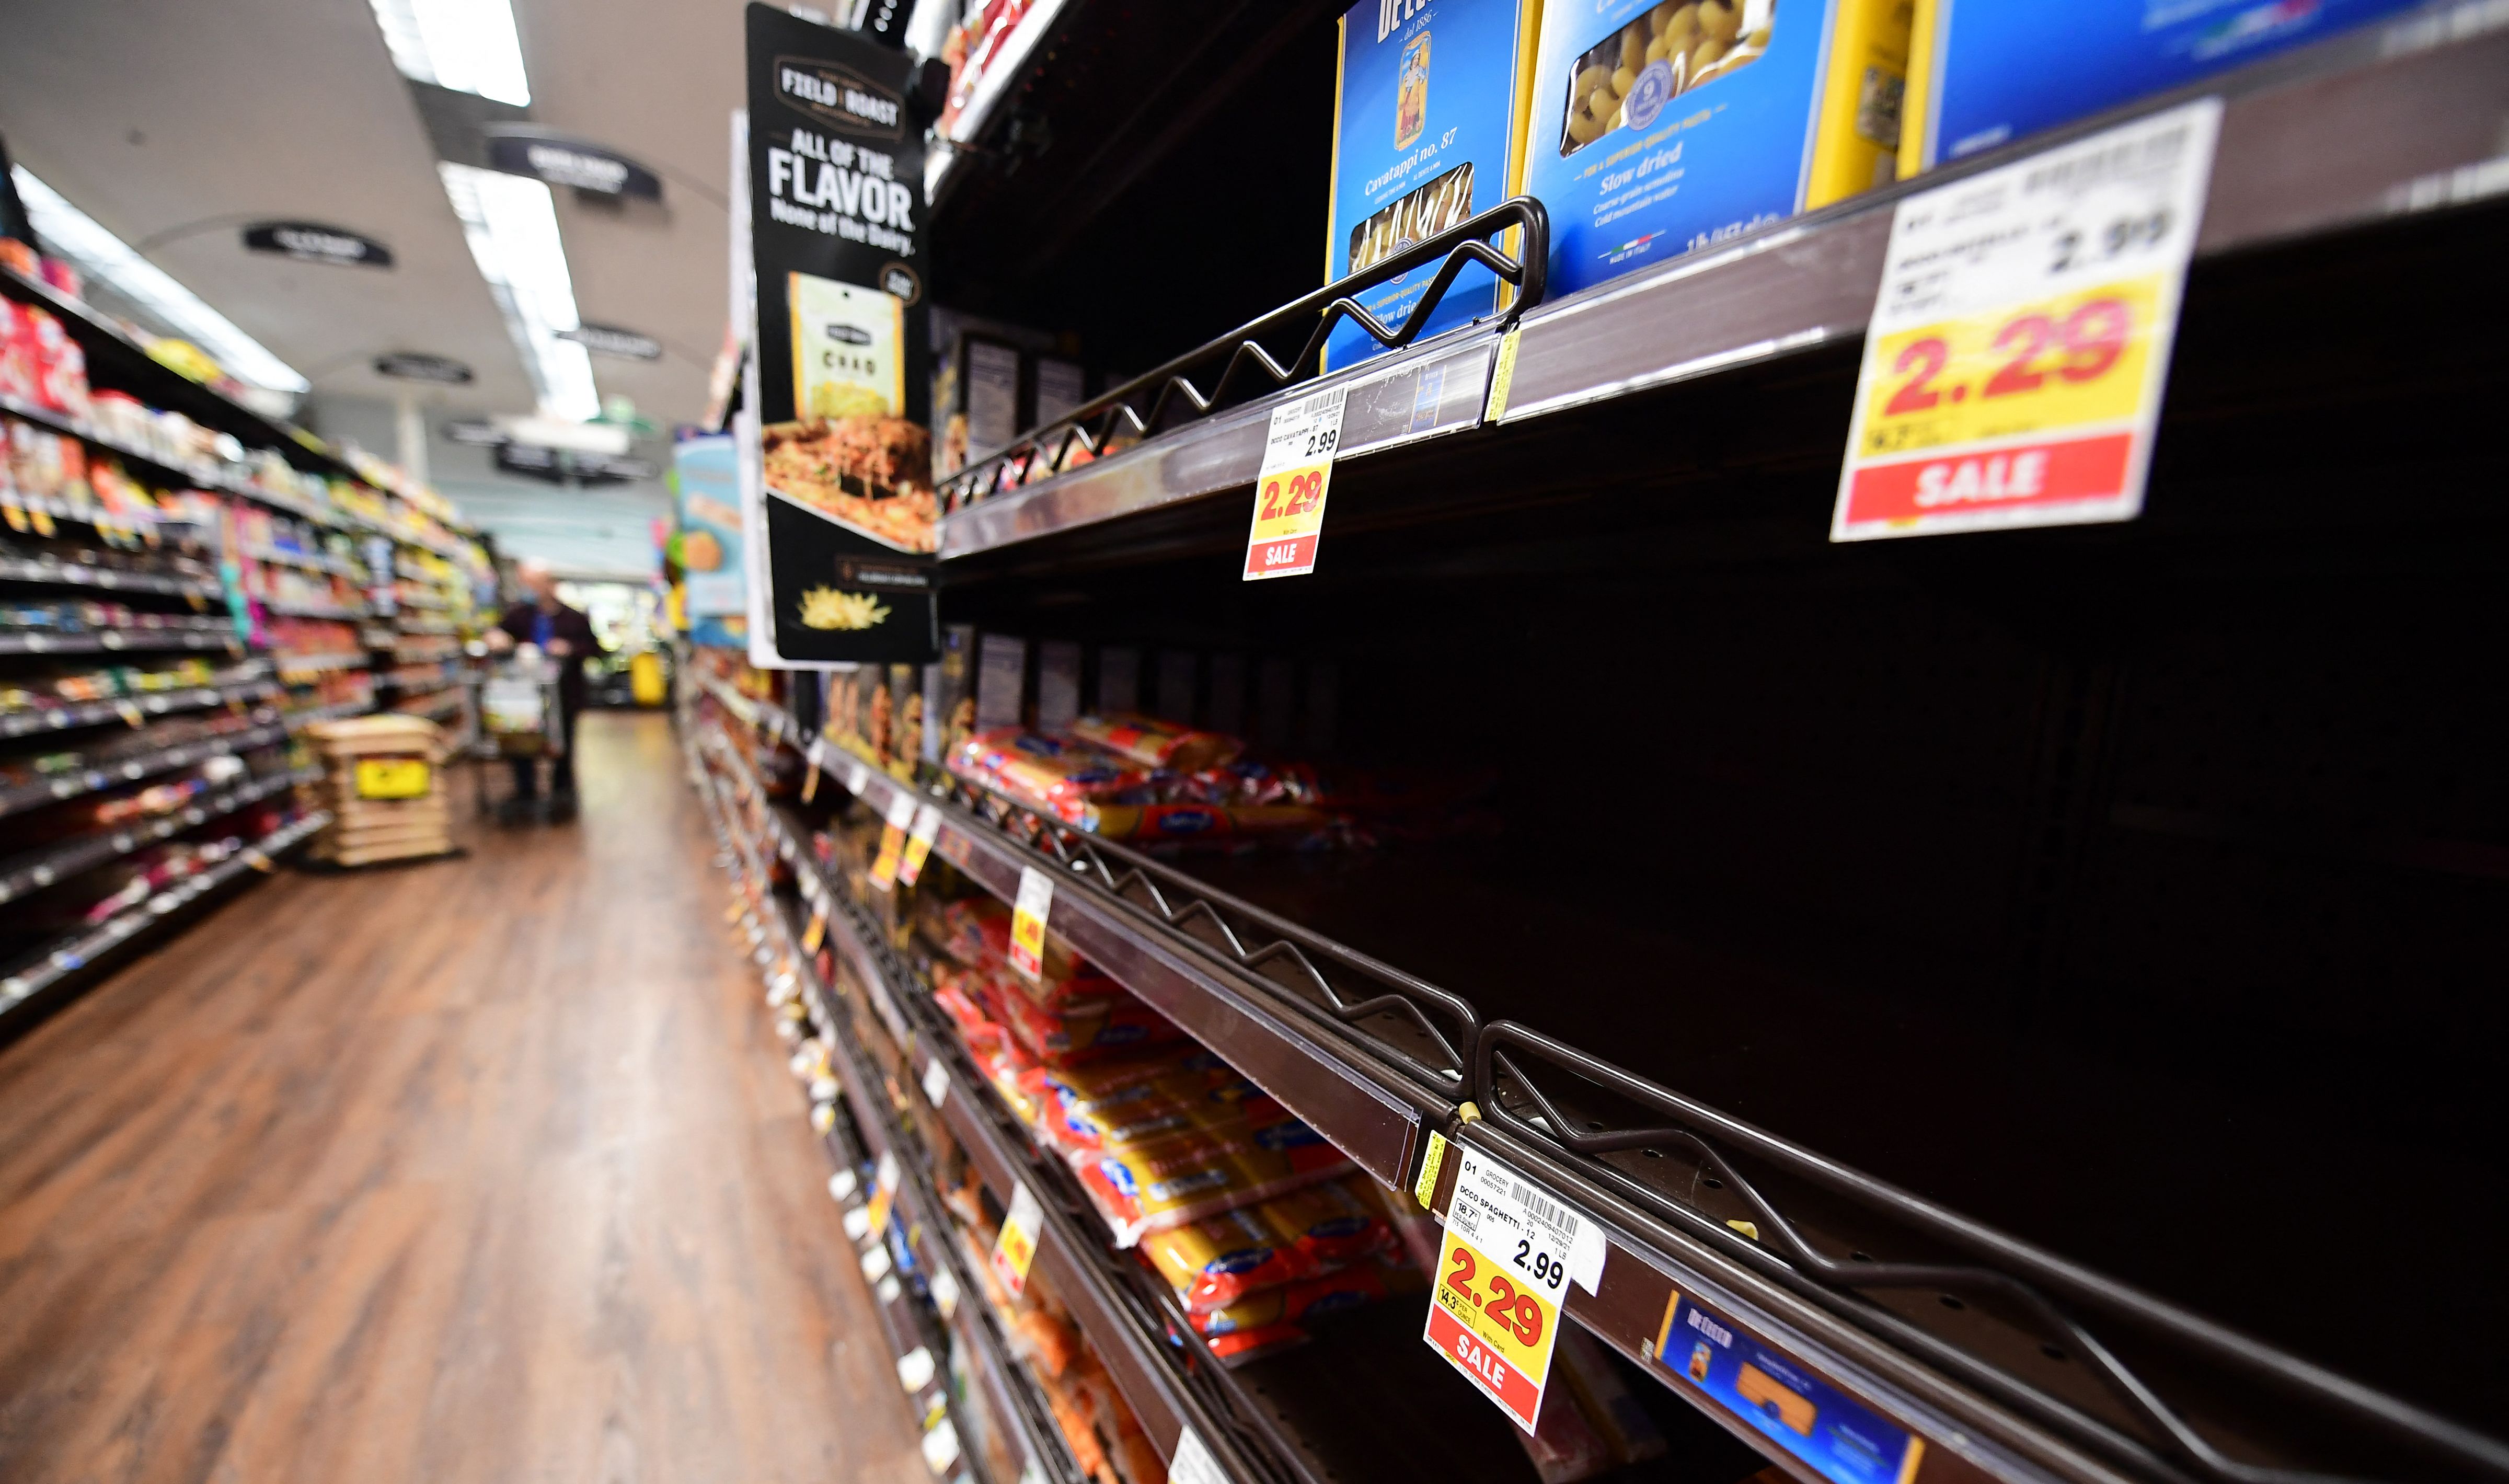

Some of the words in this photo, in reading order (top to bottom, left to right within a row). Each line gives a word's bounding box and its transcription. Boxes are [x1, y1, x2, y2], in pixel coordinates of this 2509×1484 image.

[1415, 9, 1432, 32] 1886
[780, 66, 837, 107] FIELD
[845, 89, 899, 127] ROAST
[791, 127, 828, 162] ALL
[830, 139, 855, 169] OF
[857, 147, 894, 181] THE
[1365, 148, 1419, 196] Cavatappi
[1420, 144, 1437, 162] no.
[1441, 126, 1457, 149] 87
[1584, 163, 1598, 178] FOR
[1598, 162, 1604, 171] A
[1599, 168, 1636, 196] Slow
[1636, 141, 1683, 178] dried
[770, 196, 818, 231] None
[818, 211, 837, 235] of
[838, 215, 867, 243] the
[1595, 212, 1613, 228] Cold
[1613, 196, 1653, 220] mountain
[1653, 184, 1679, 203] water
[1609, 252, 1624, 265] MADE
[1625, 249, 1631, 258] IN
[1633, 242, 1651, 255] ITALY
[2047, 207, 2170, 274] 2.99
[1397, 296, 1423, 318] drie
[1883, 298, 2128, 417] 2.29
[1274, 416, 1282, 425] 01
[1283, 428, 1309, 441] CAVATAPPI
[1305, 429, 1337, 457] 2.99
[1912, 449, 2050, 508] SALE
[1261, 471, 1322, 521] 2.29
[1265, 543, 1297, 566] SALE
[1465, 1161, 1477, 1175] 01
[1486, 1170, 1509, 1188] GROCERY
[1480, 1177, 1506, 1197] 00057221
[1460, 1186, 1478, 1202] DCCO
[1480, 1199, 1520, 1230] SPAGHETTI
[1526, 1229, 1535, 1240] 12
[1462, 1217, 1476, 1230] OUNCE
[1548, 1233, 1570, 1251] 12/29/21
[1559, 1250, 1567, 1260] LB
[1513, 1239, 1563, 1289] 2.99
[1447, 1247, 1543, 1347] 2.29
[1459, 1303, 1468, 1313] PER
[1458, 1310, 1470, 1324] OUNCE
[1483, 1330, 1493, 1343] With
[1493, 1340, 1505, 1353] Card
[1457, 1334, 1505, 1390] SALE
